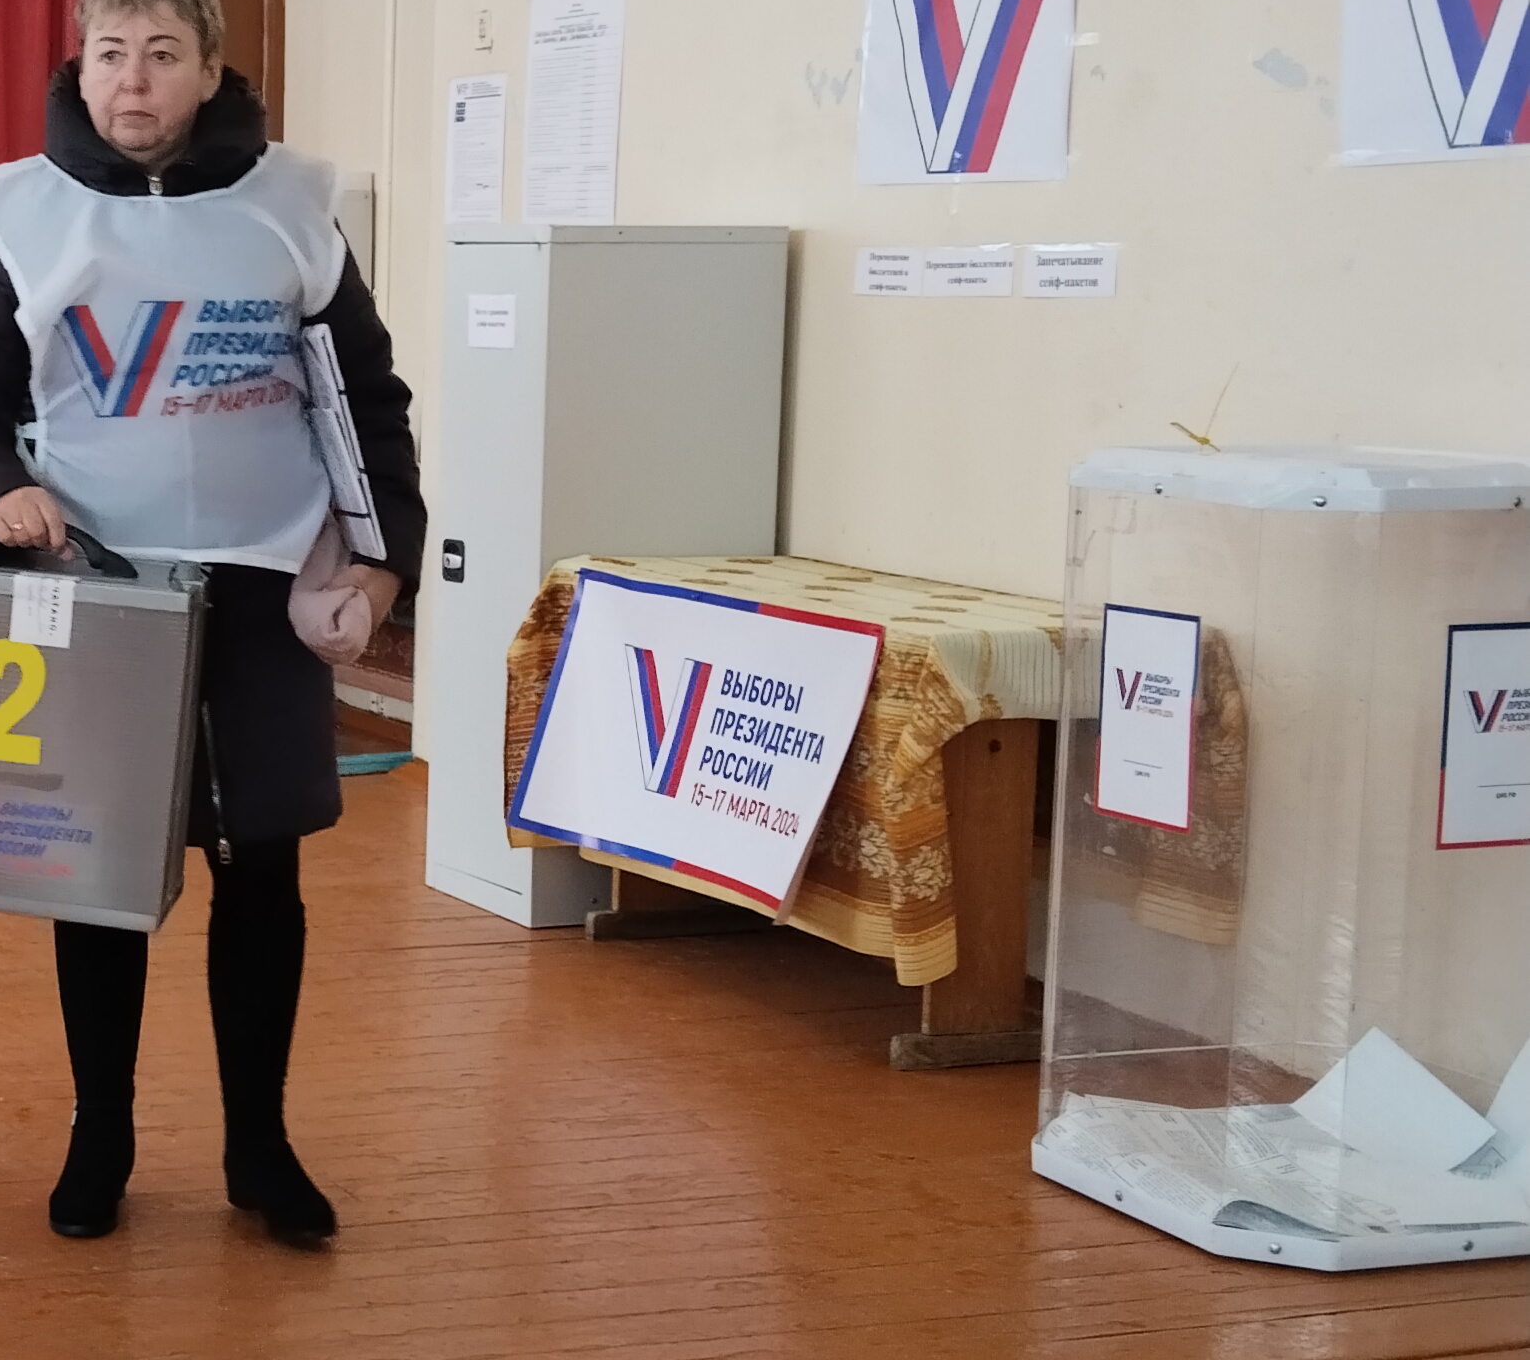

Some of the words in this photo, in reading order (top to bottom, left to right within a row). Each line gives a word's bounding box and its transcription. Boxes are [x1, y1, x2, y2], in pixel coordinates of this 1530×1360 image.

[1036, 255, 1104, 267] Запечатывание
[1039, 276, 1099, 291] сейф-пакетов
[720, 669, 804, 714] ВЫБОРЫ
[710, 707, 825, 764] ПРЕЗИДЕНТА
[699, 745, 773, 791] РОССИИ
[726, 793, 771, 829] МАРТА
[771, 808, 801, 839] 2024
